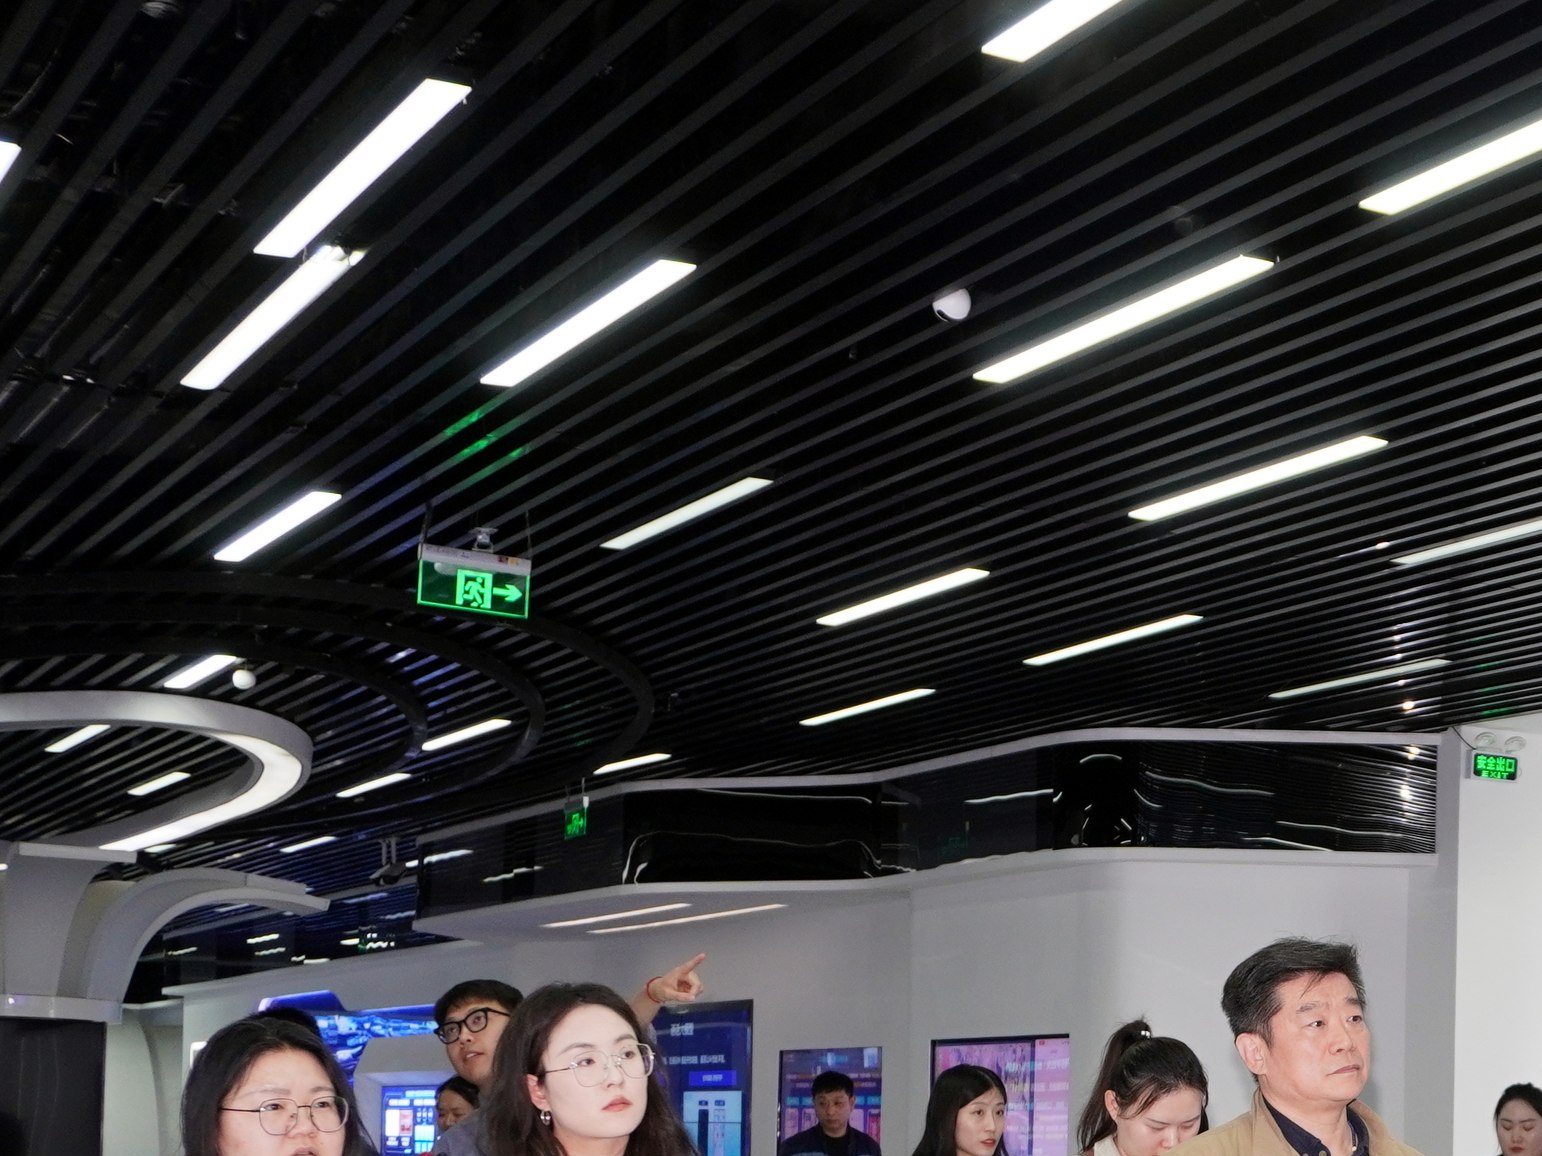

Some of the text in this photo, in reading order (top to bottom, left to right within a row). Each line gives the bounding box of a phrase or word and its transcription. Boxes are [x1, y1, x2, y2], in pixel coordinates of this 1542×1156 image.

[1477, 755, 1516, 771] 安全出口
[1481, 770, 1508, 779] EXIT
